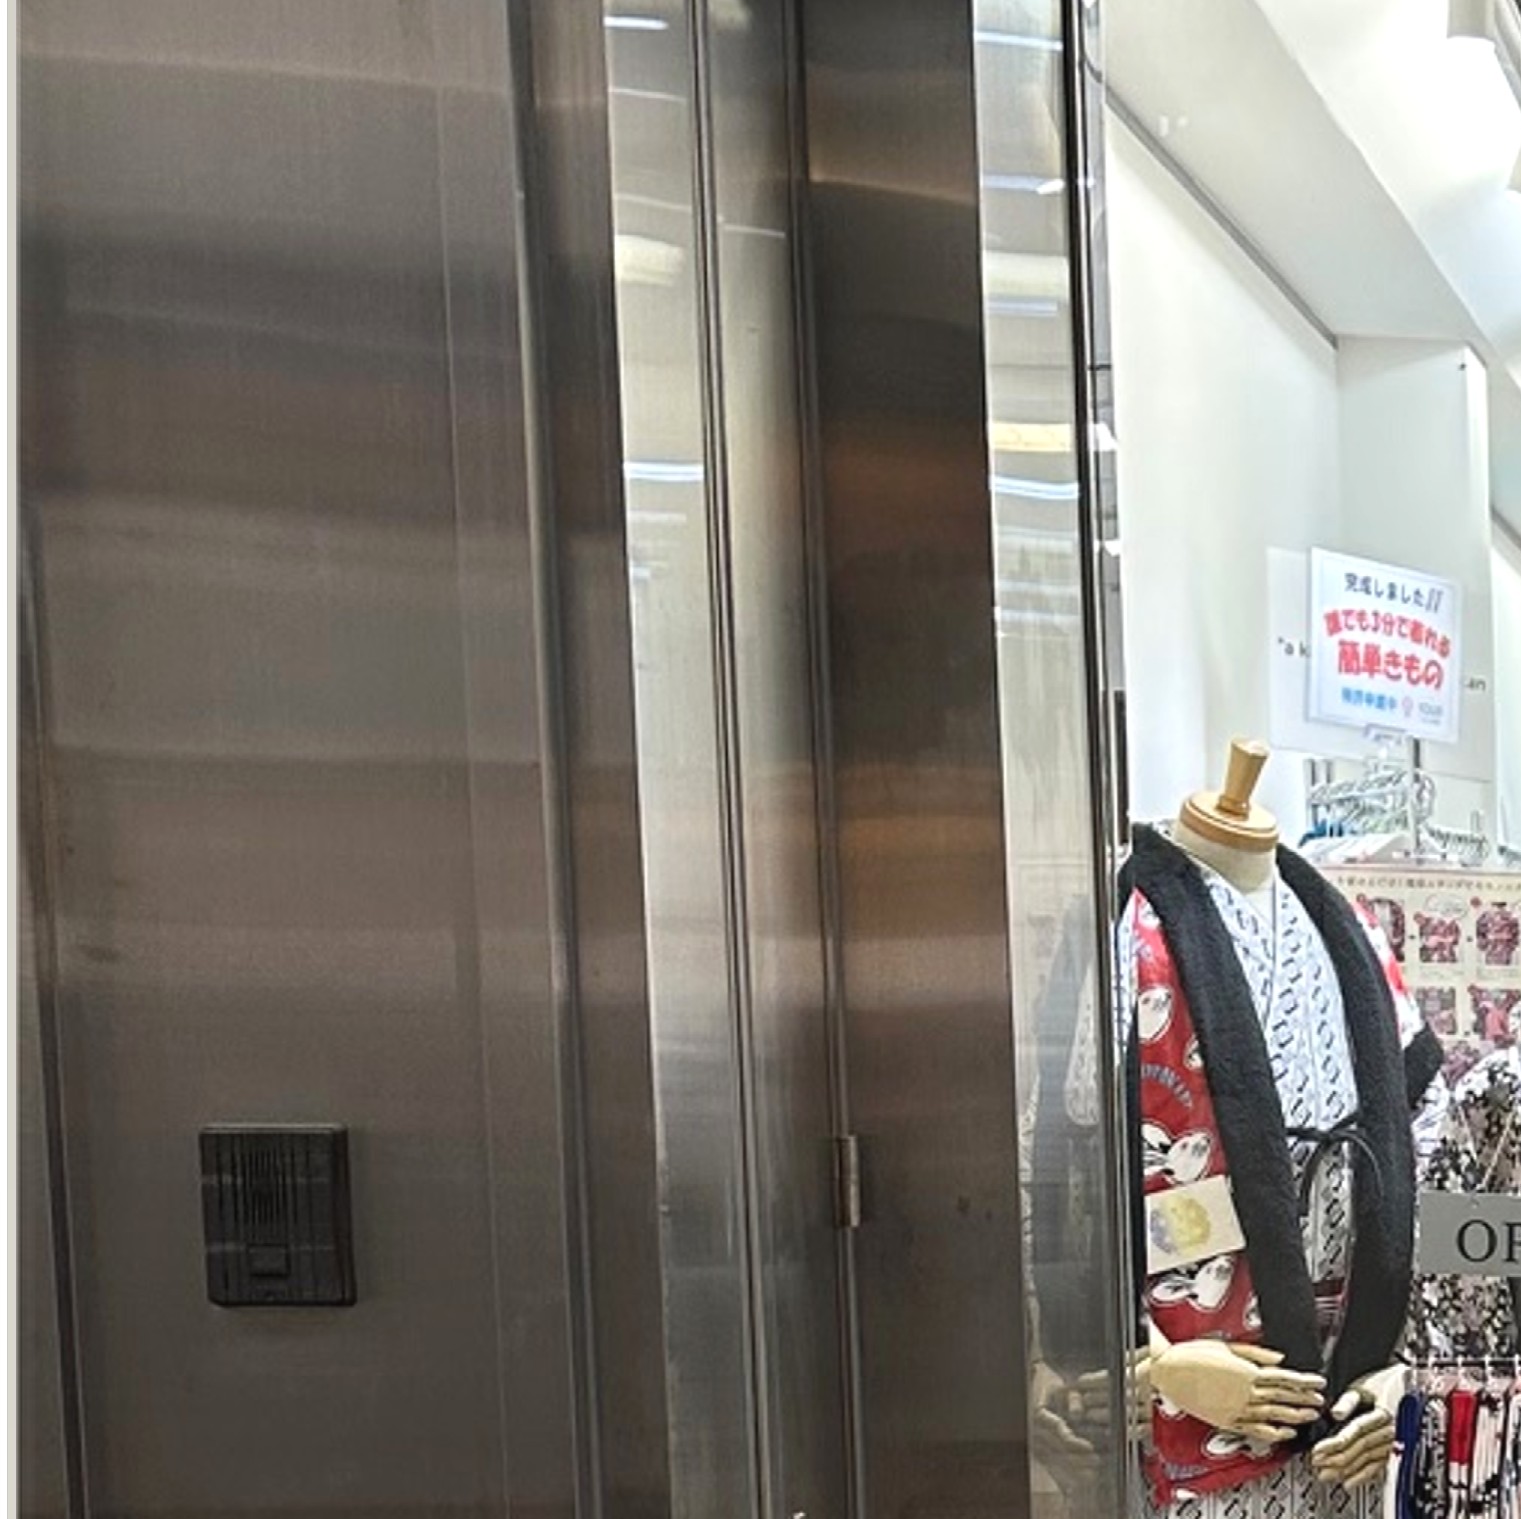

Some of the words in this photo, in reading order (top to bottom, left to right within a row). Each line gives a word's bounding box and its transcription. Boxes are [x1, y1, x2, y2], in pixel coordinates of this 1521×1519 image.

[1337, 638, 1445, 691] 簡単きもの
